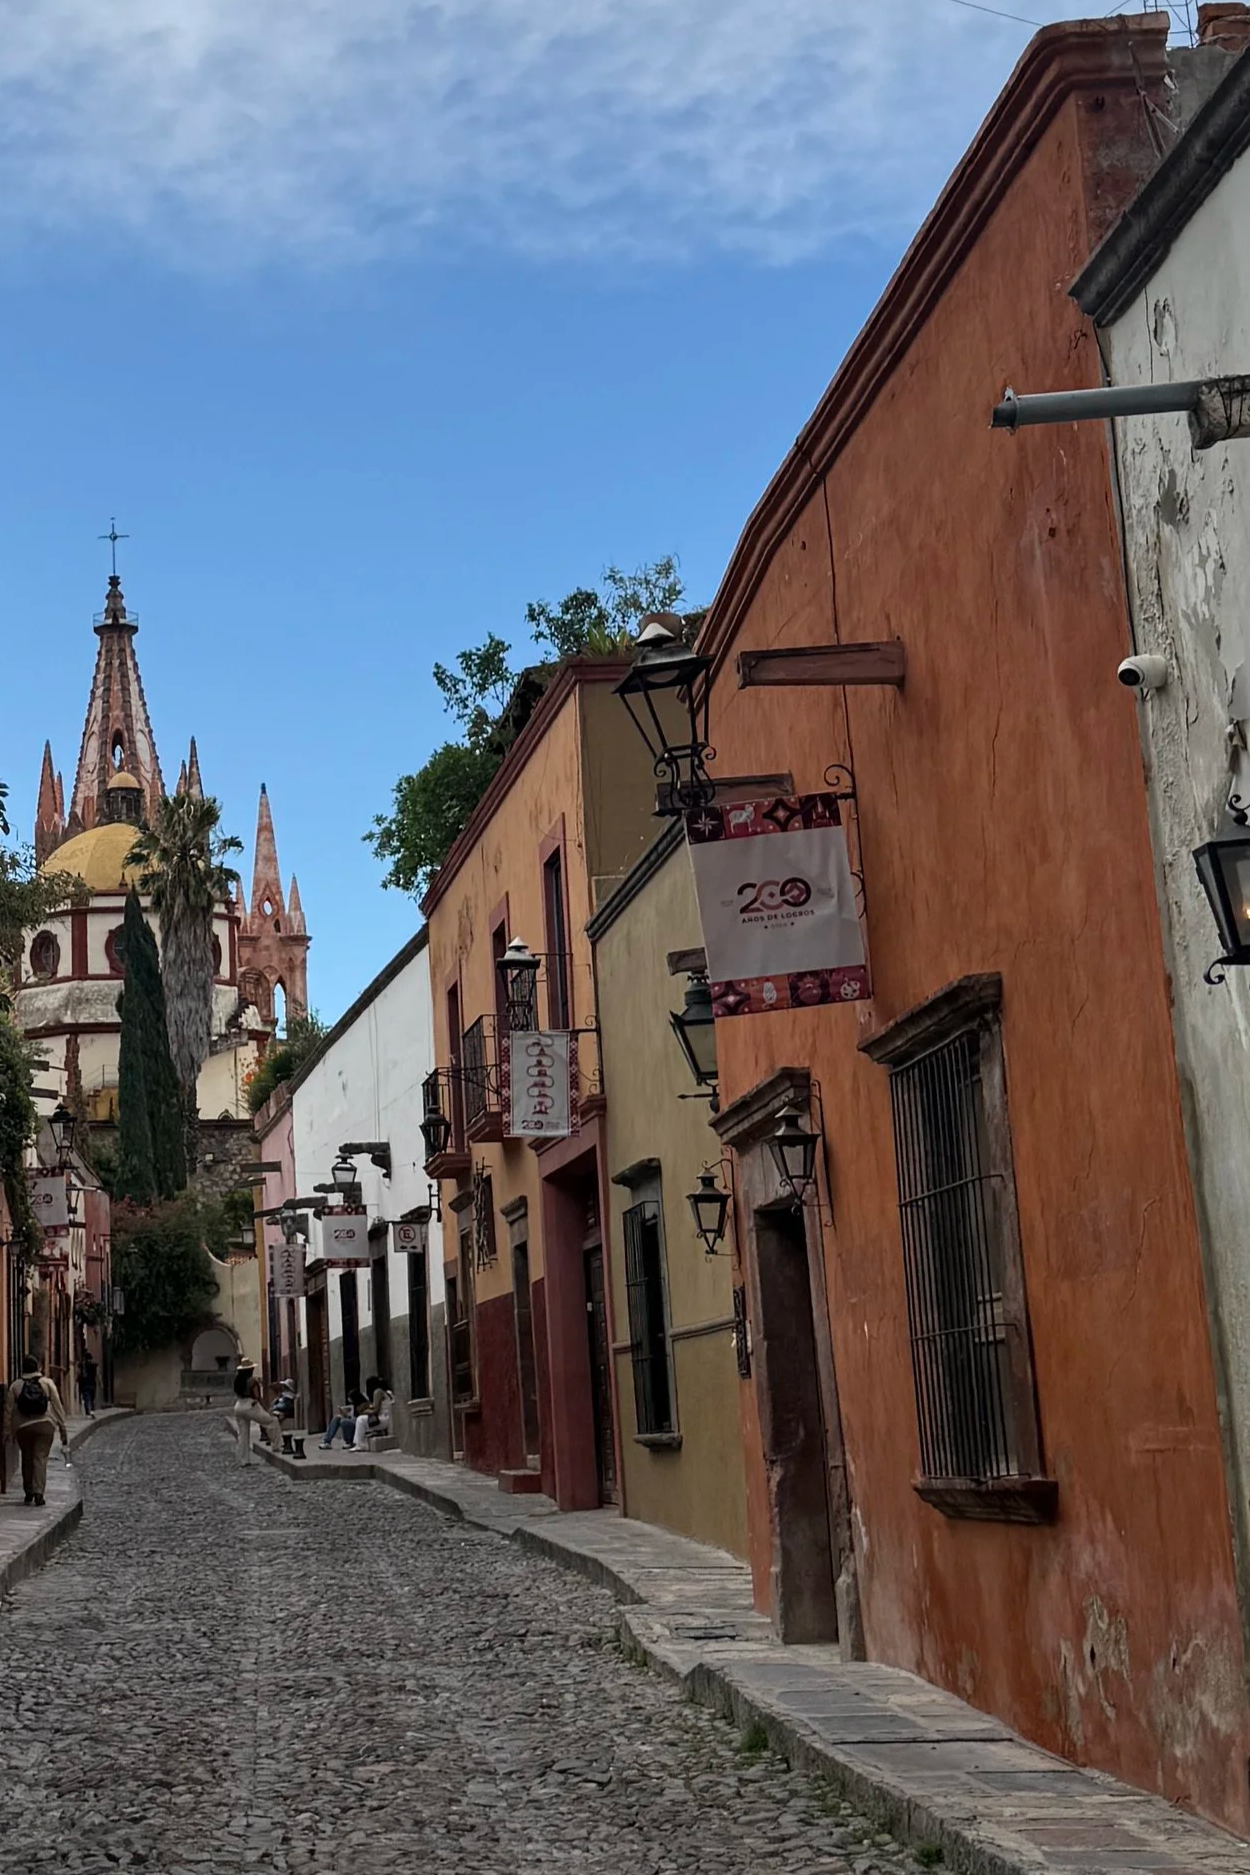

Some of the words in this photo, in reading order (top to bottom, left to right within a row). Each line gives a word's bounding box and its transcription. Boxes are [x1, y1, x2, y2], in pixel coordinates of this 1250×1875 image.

[737, 877, 812, 914] 200
[767, 913, 777, 921] DE
[781, 909, 815, 919] LOGROS
[403, 1228, 411, 1239] E
